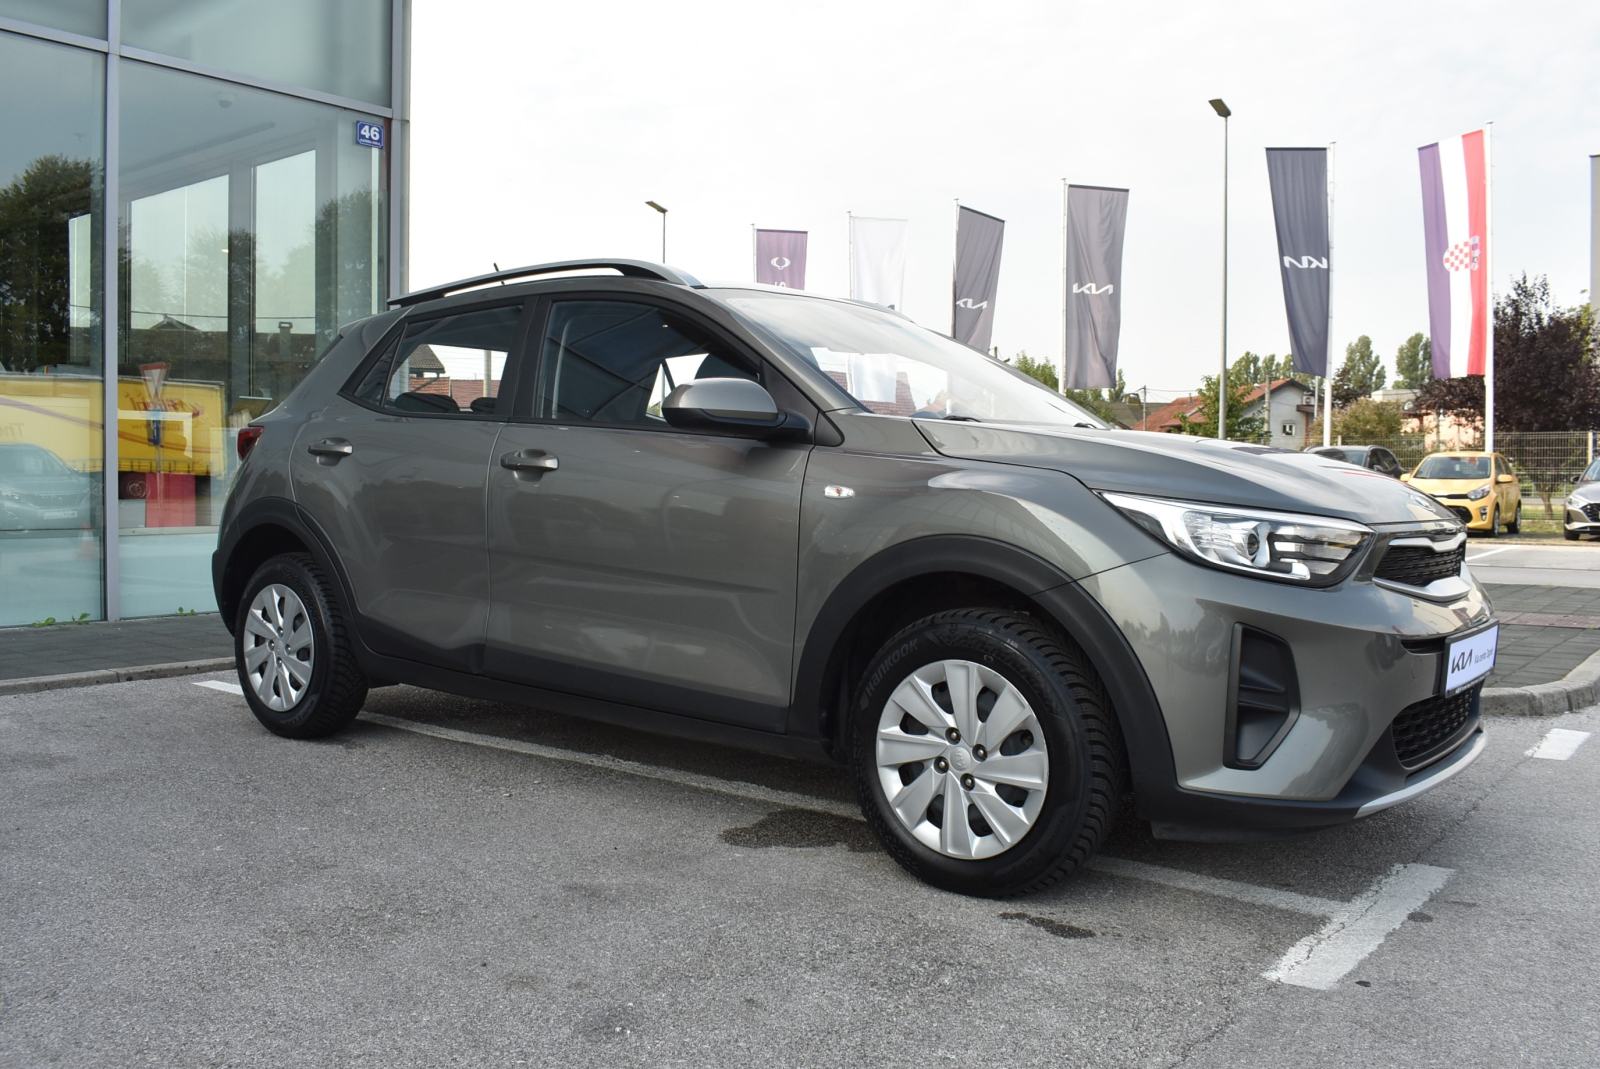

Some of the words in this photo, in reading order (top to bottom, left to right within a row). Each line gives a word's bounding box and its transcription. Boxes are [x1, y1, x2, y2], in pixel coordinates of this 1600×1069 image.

[360, 125, 380, 141] 46
[1072, 282, 1114, 295] KIA
[1451, 648, 1473, 674] KIA
